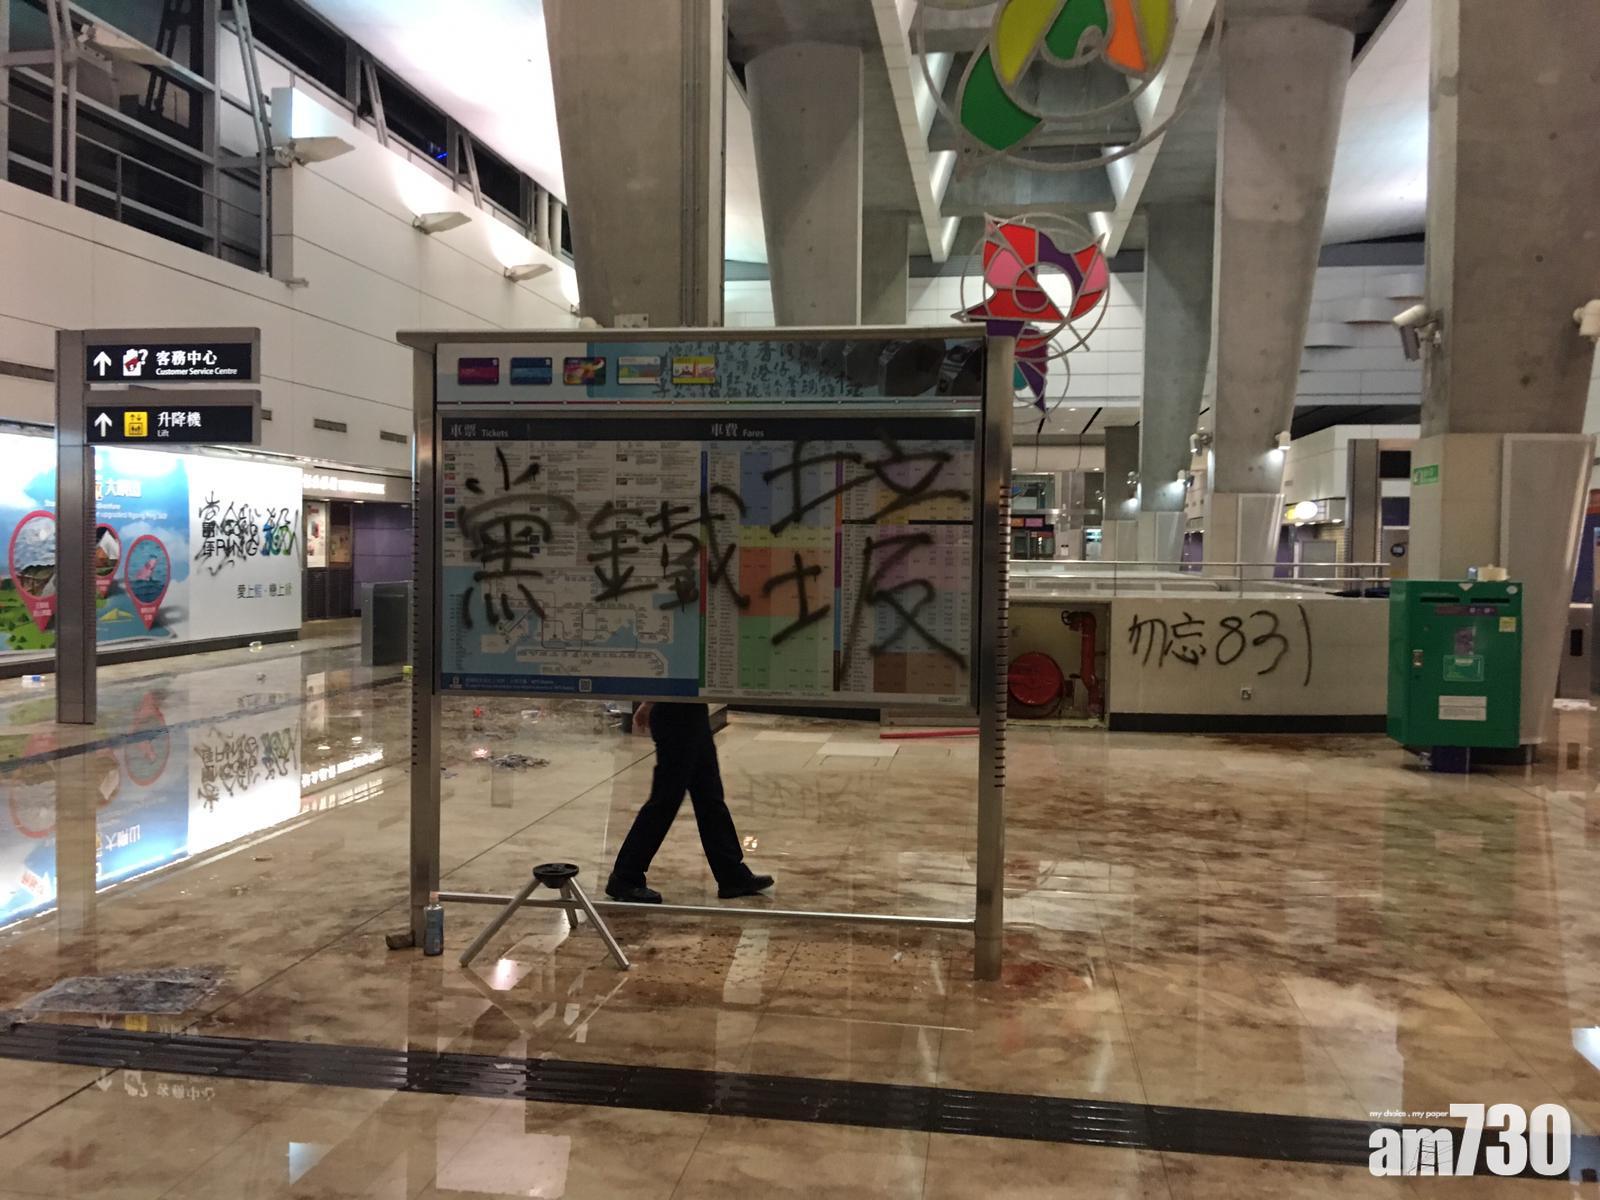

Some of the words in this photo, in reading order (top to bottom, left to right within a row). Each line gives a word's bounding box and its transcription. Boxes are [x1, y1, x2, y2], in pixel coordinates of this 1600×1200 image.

[156, 350, 218, 366] 客務中心
[156, 368, 188, 376] Customer
[189, 367, 214, 375] Service
[214, 367, 237, 375] Centre
[157, 411, 202, 428] 升降機
[157, 429, 170, 438] Lift
[482, 429, 509, 438] Tickets
